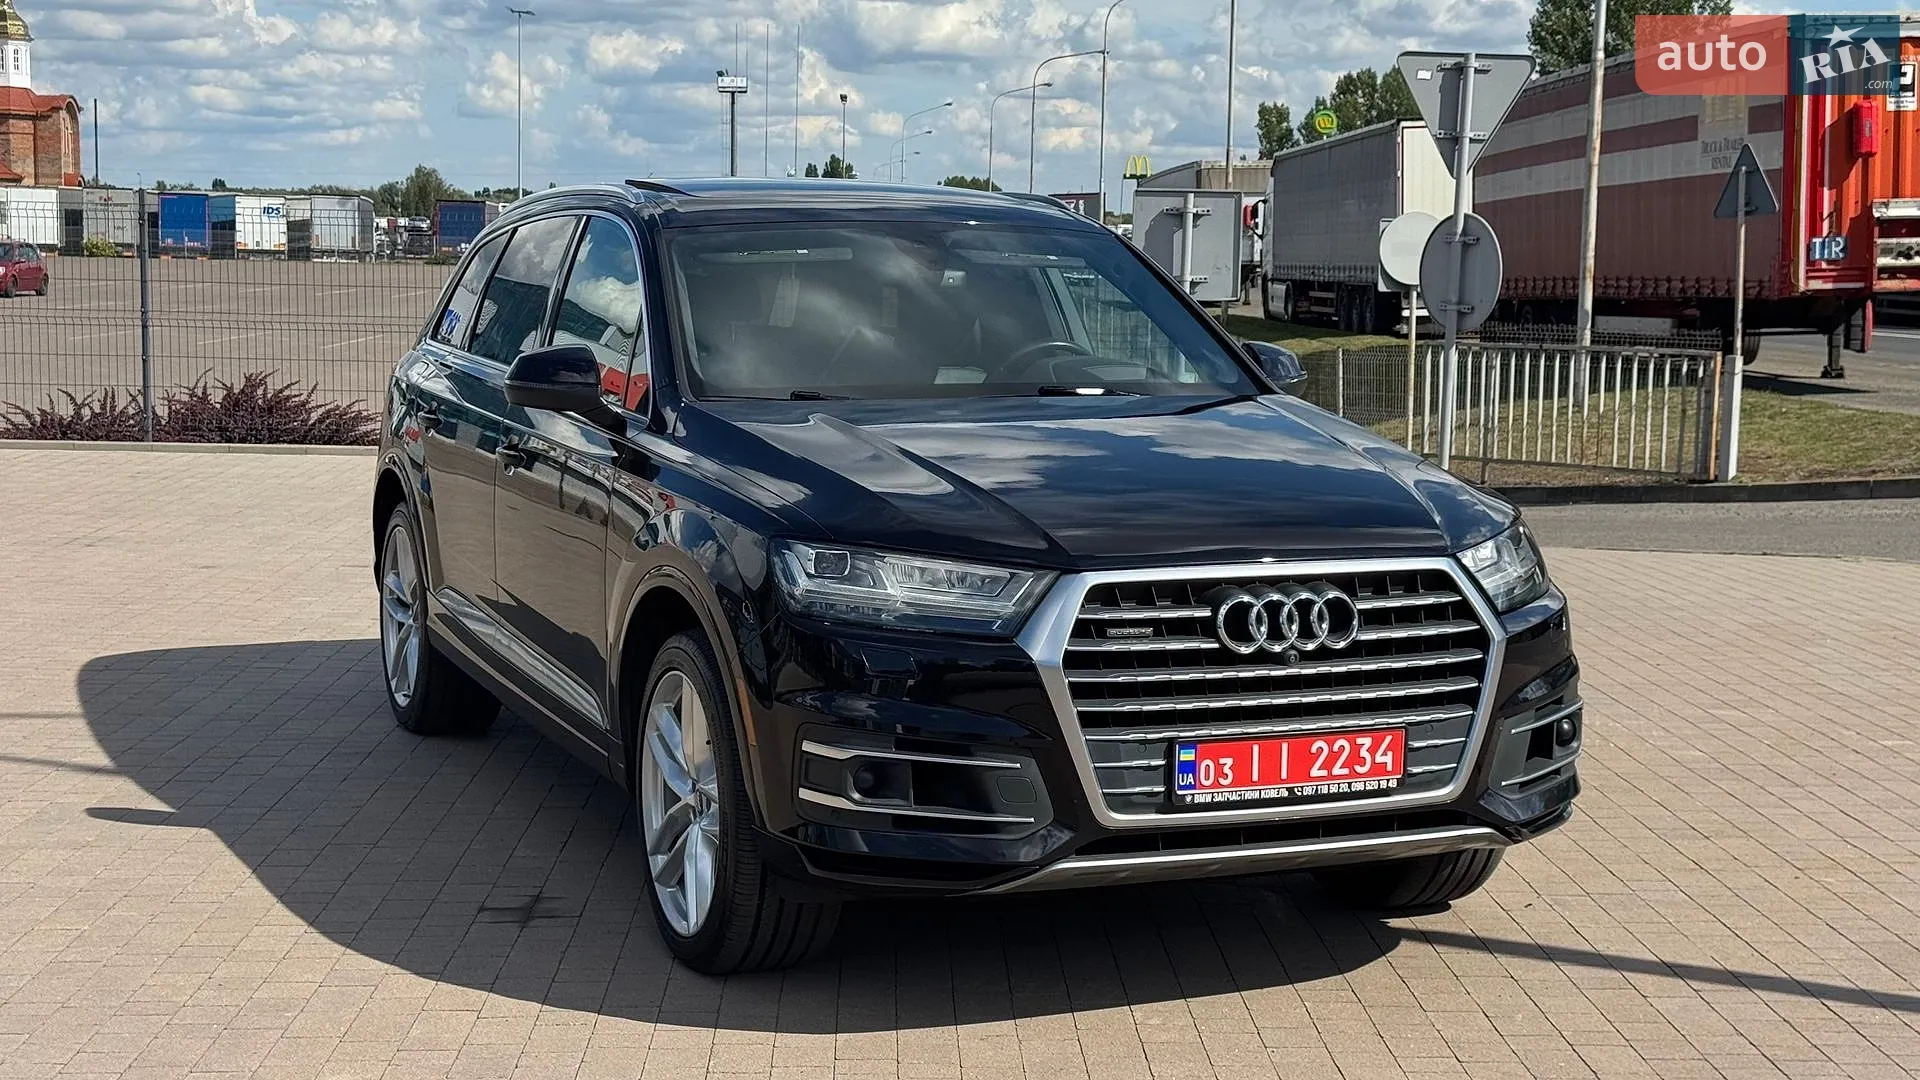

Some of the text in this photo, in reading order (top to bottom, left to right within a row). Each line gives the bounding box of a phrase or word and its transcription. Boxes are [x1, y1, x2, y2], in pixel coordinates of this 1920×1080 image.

[262, 206, 281, 216] IDS
[1811, 236, 1845, 259] TIR
[1200, 757, 1234, 787] 03
[1309, 735, 1393, 778] 2234
[1179, 773, 1194, 786] UA
[1194, 793, 1212, 803] BMW
[1260, 787, 1289, 799] КОВЕЛЬ
